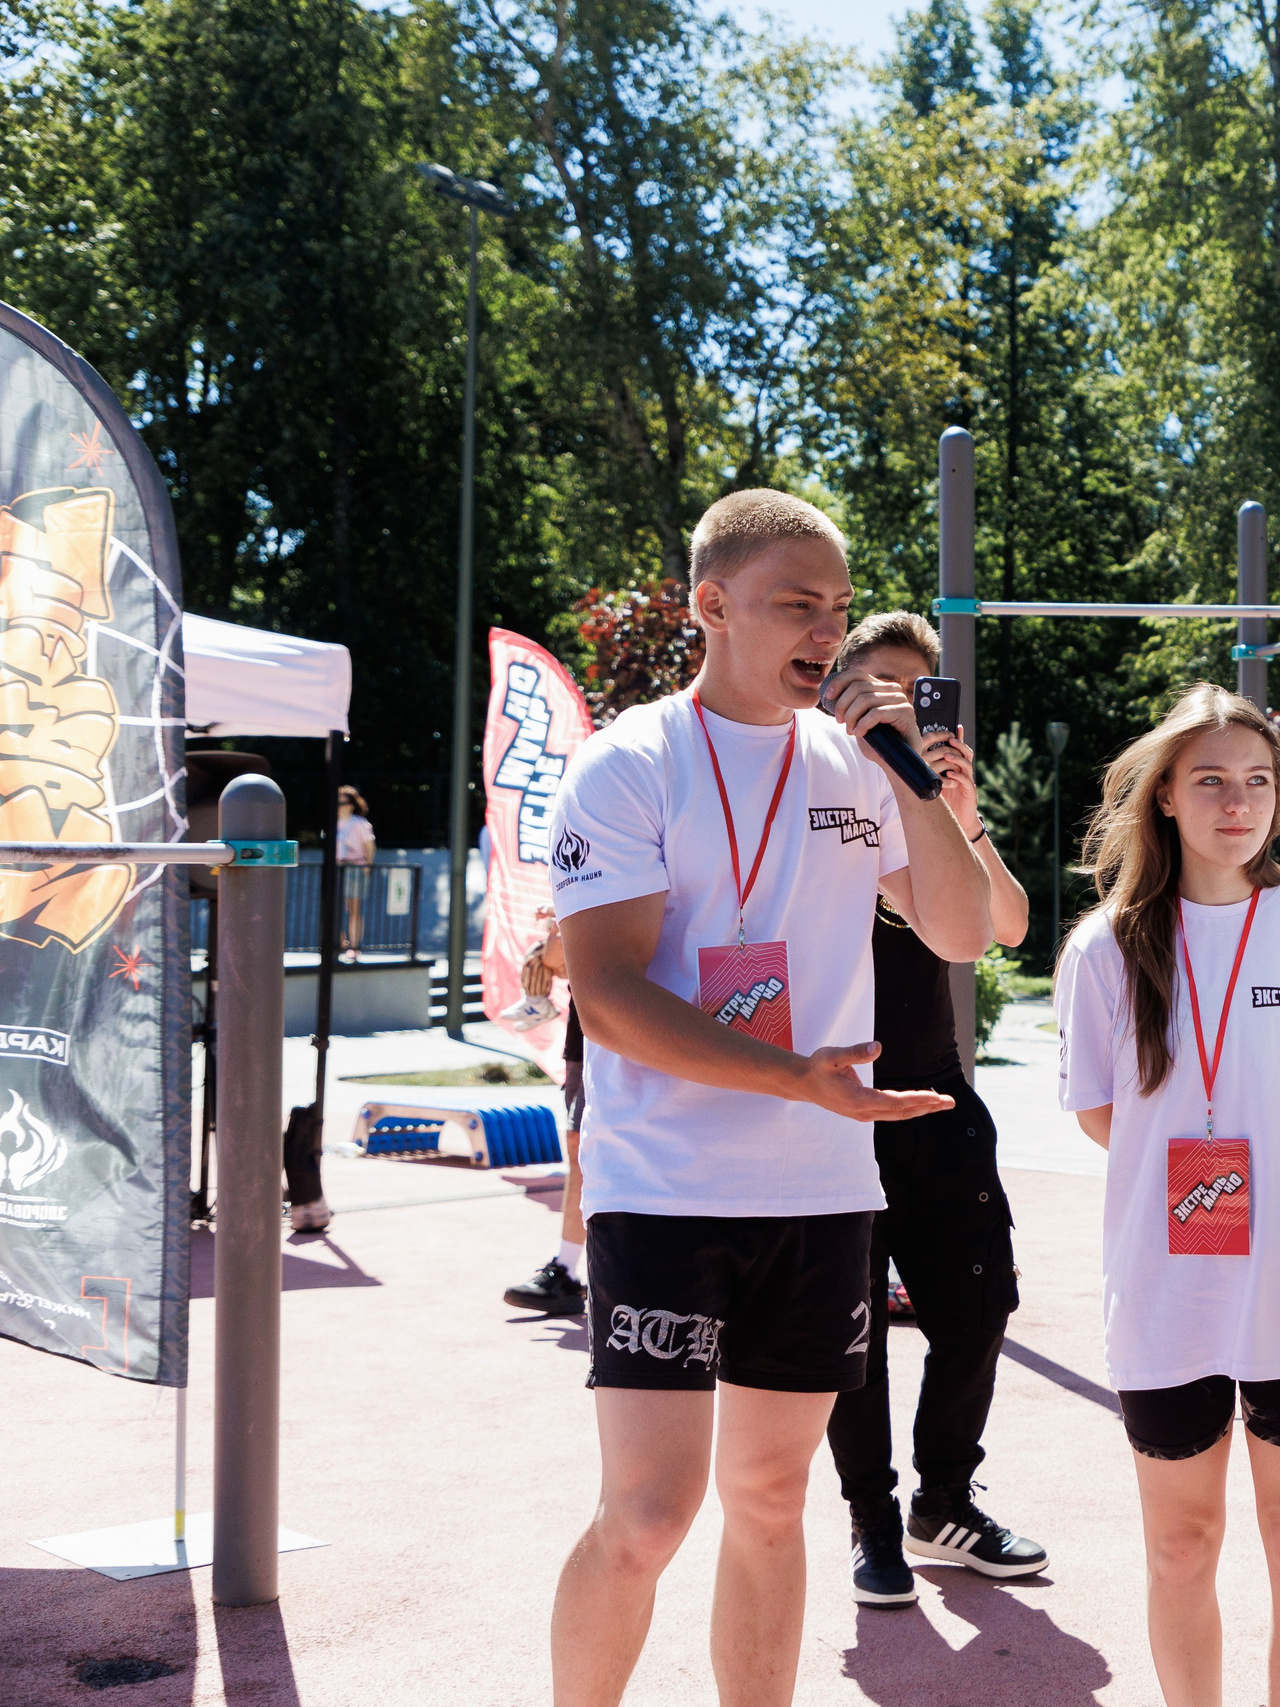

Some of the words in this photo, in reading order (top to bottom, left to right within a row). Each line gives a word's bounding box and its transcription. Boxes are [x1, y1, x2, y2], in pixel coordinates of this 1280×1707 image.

[810, 810, 856, 828] ЭКСТРЕ
[842, 821, 875, 841] МАЛЬ
[865, 831, 880, 845] Н
[581, 870, 603, 882] НАЦИЯ
[762, 977, 783, 1000] НО
[739, 983, 767, 1019] МАЛЬ
[1201, 1176, 1227, 1211] МАЛЬ
[1223, 1172, 1243, 1194] НО
[1173, 1183, 1208, 1222] ЭКСТРЕ
